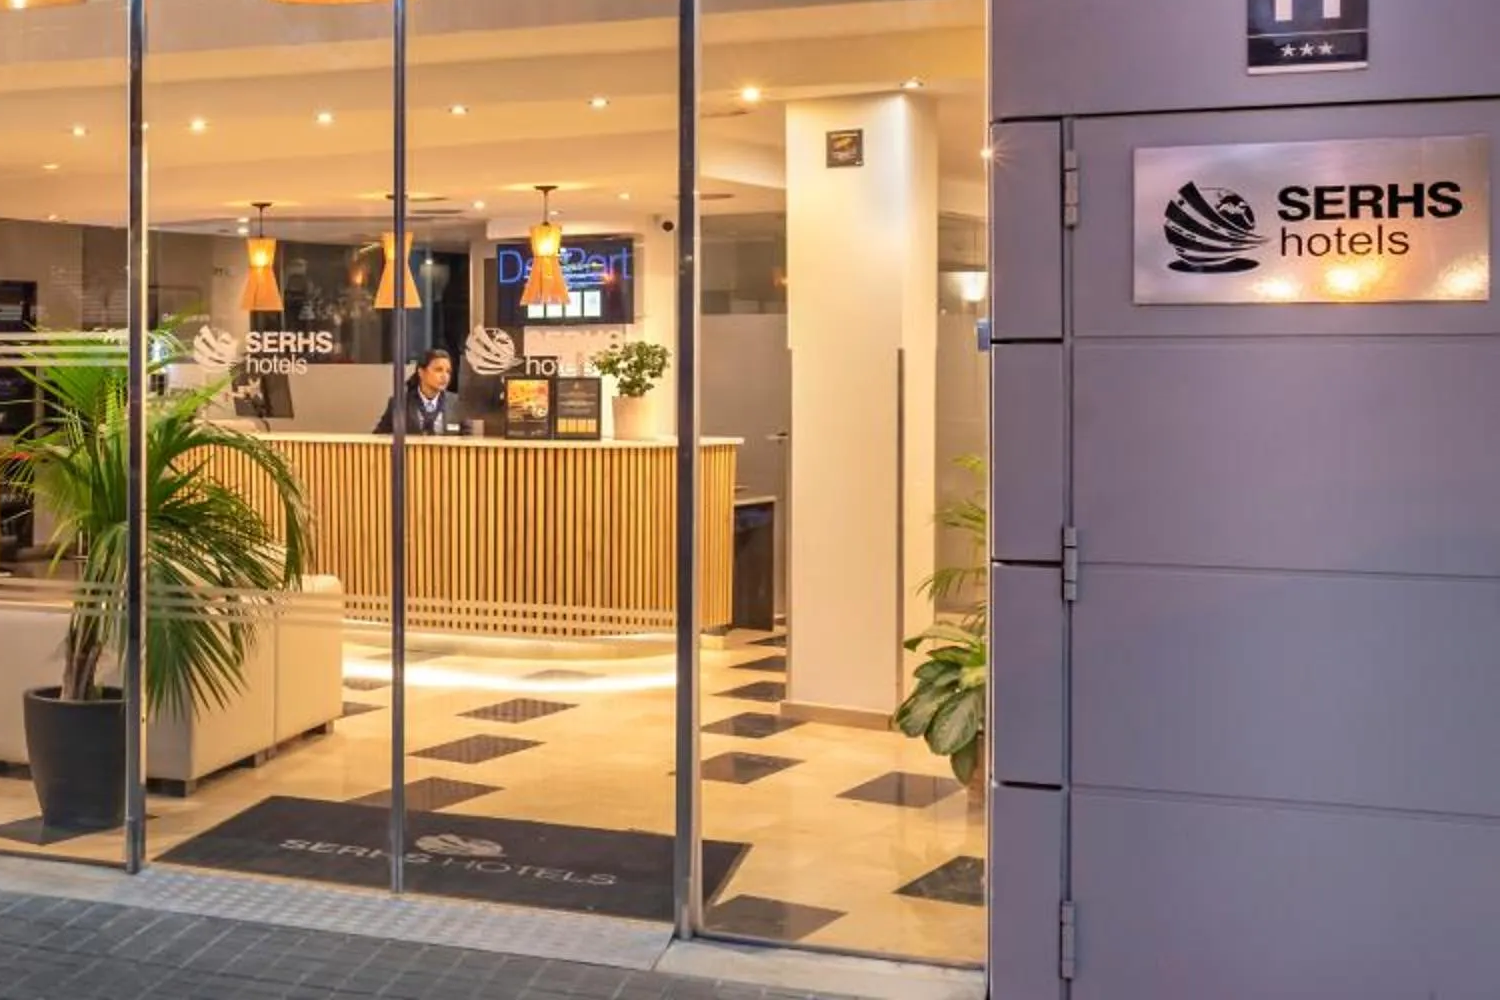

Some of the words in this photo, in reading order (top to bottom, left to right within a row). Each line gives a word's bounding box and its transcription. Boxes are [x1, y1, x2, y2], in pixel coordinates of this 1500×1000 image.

[1277, 181, 1463, 222] SERHS
[1280, 224, 1411, 257] hotels
[244, 331, 333, 353] SERHS
[245, 353, 308, 375] hotels
